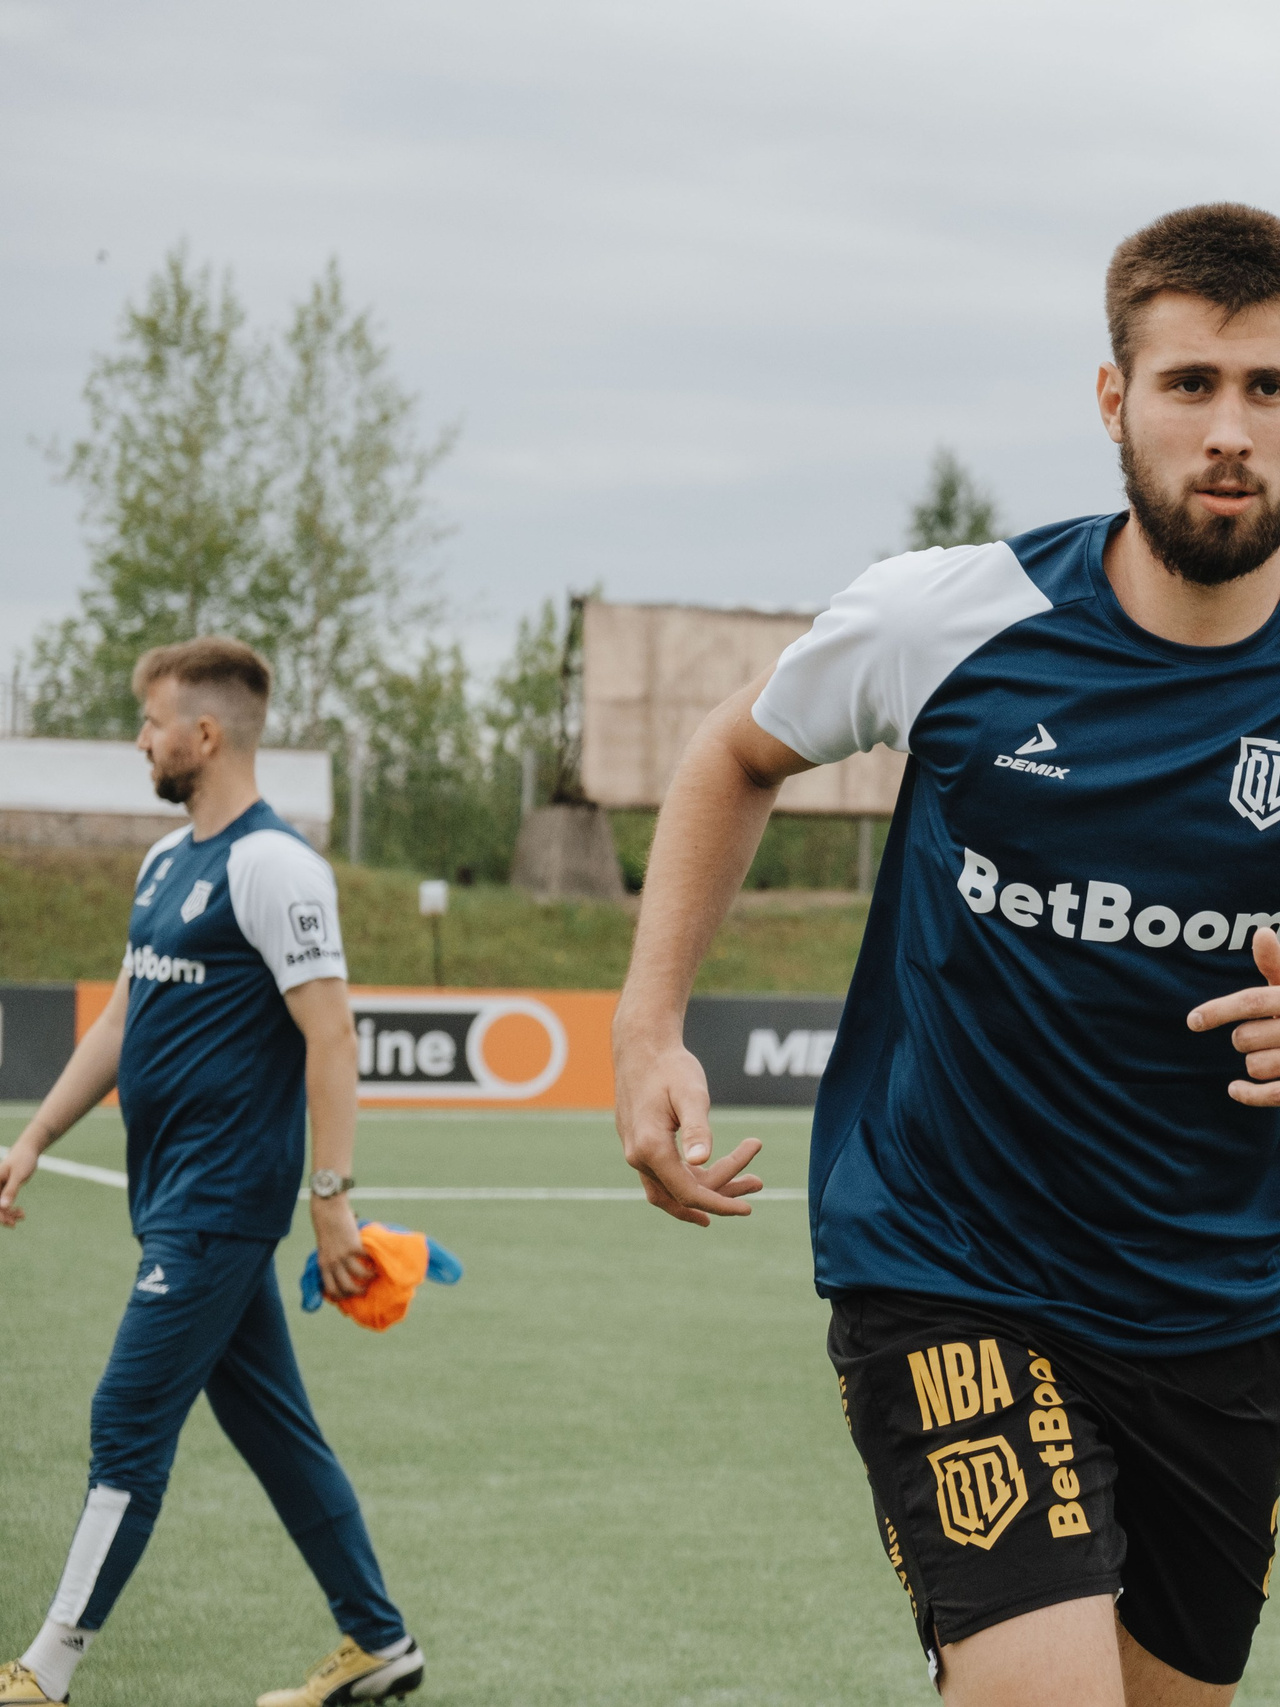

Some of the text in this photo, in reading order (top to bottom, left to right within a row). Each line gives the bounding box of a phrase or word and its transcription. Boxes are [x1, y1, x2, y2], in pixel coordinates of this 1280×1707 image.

[993, 754, 1071, 780] DEMIX
[357, 1016, 457, 1078] ine
[743, 1028, 838, 1077] ME
[906, 1338, 1015, 1431] NBA
[1027, 1348, 1092, 1539] BetBoo
